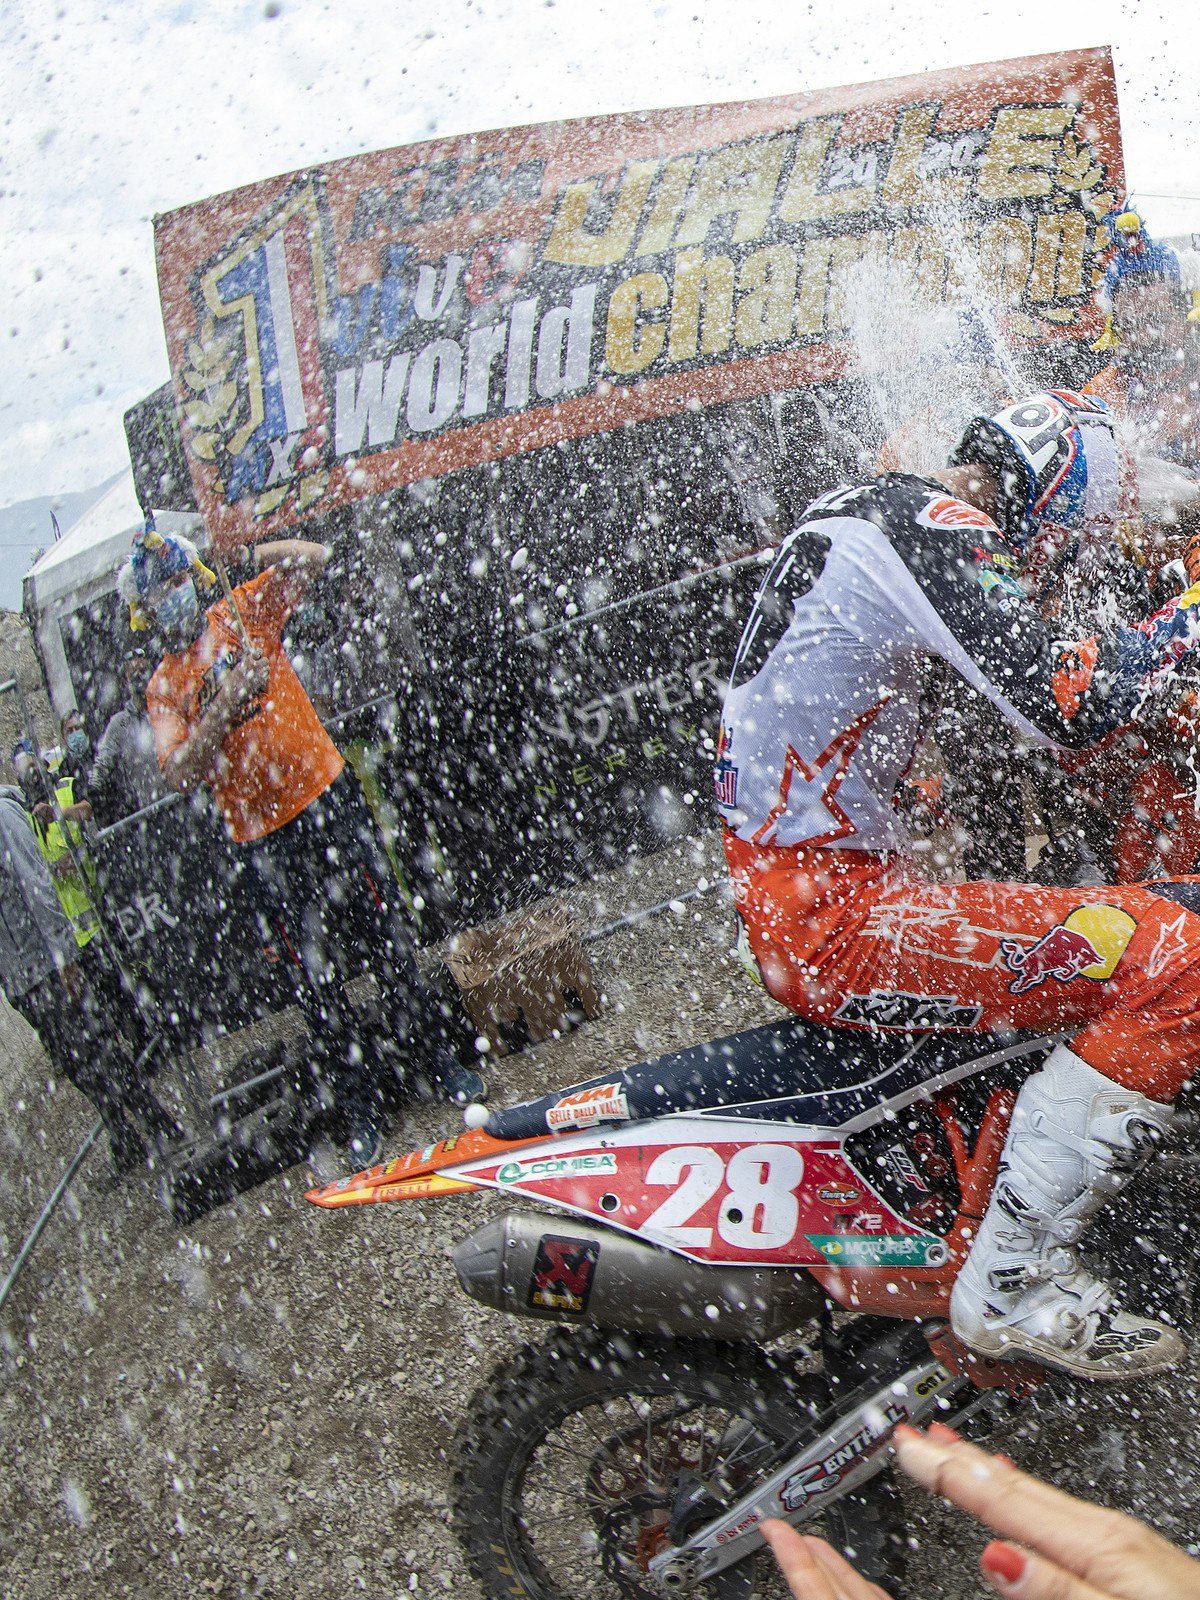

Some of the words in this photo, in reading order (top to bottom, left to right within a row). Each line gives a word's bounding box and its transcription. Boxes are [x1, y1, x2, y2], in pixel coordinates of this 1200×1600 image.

[333, 283, 597, 455] world
[560, 1085, 616, 1108] KTM
[549, 1109, 571, 1125] SELLE
[573, 1106, 597, 1119] DALLA
[531, 1156, 614, 1174] COMISA
[638, 1143, 805, 1250] 28
[844, 1240, 920, 1256] MOTOREX
